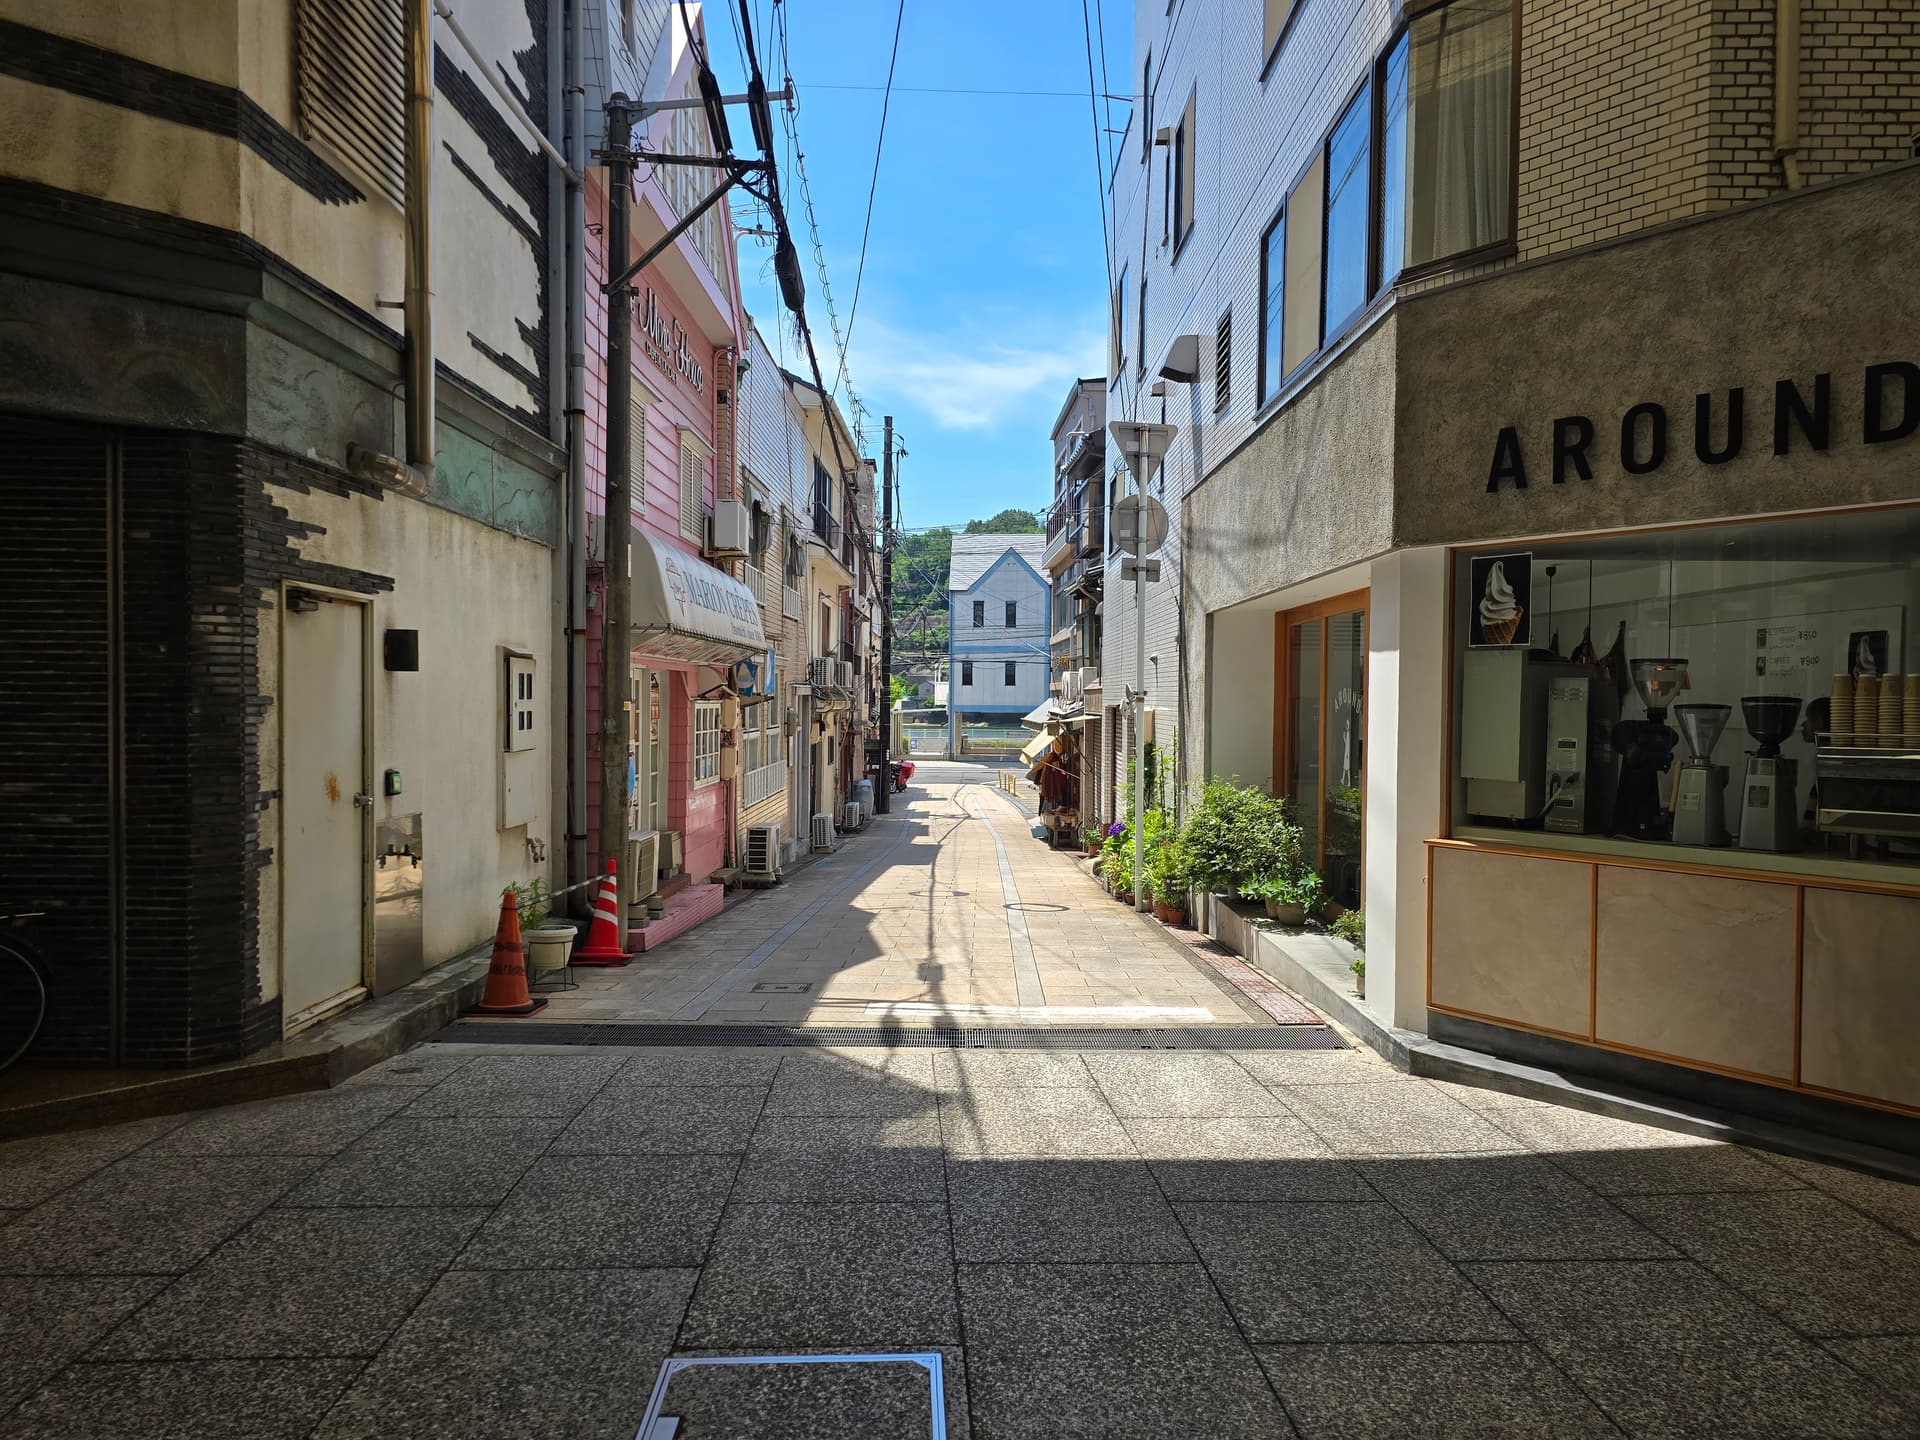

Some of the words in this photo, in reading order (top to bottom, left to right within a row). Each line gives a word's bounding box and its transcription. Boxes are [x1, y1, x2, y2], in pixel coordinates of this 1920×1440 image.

[1485, 361, 1920, 494] AROUND
[683, 570, 728, 615] MARION
[1334, 687, 1361, 713] AROUND
